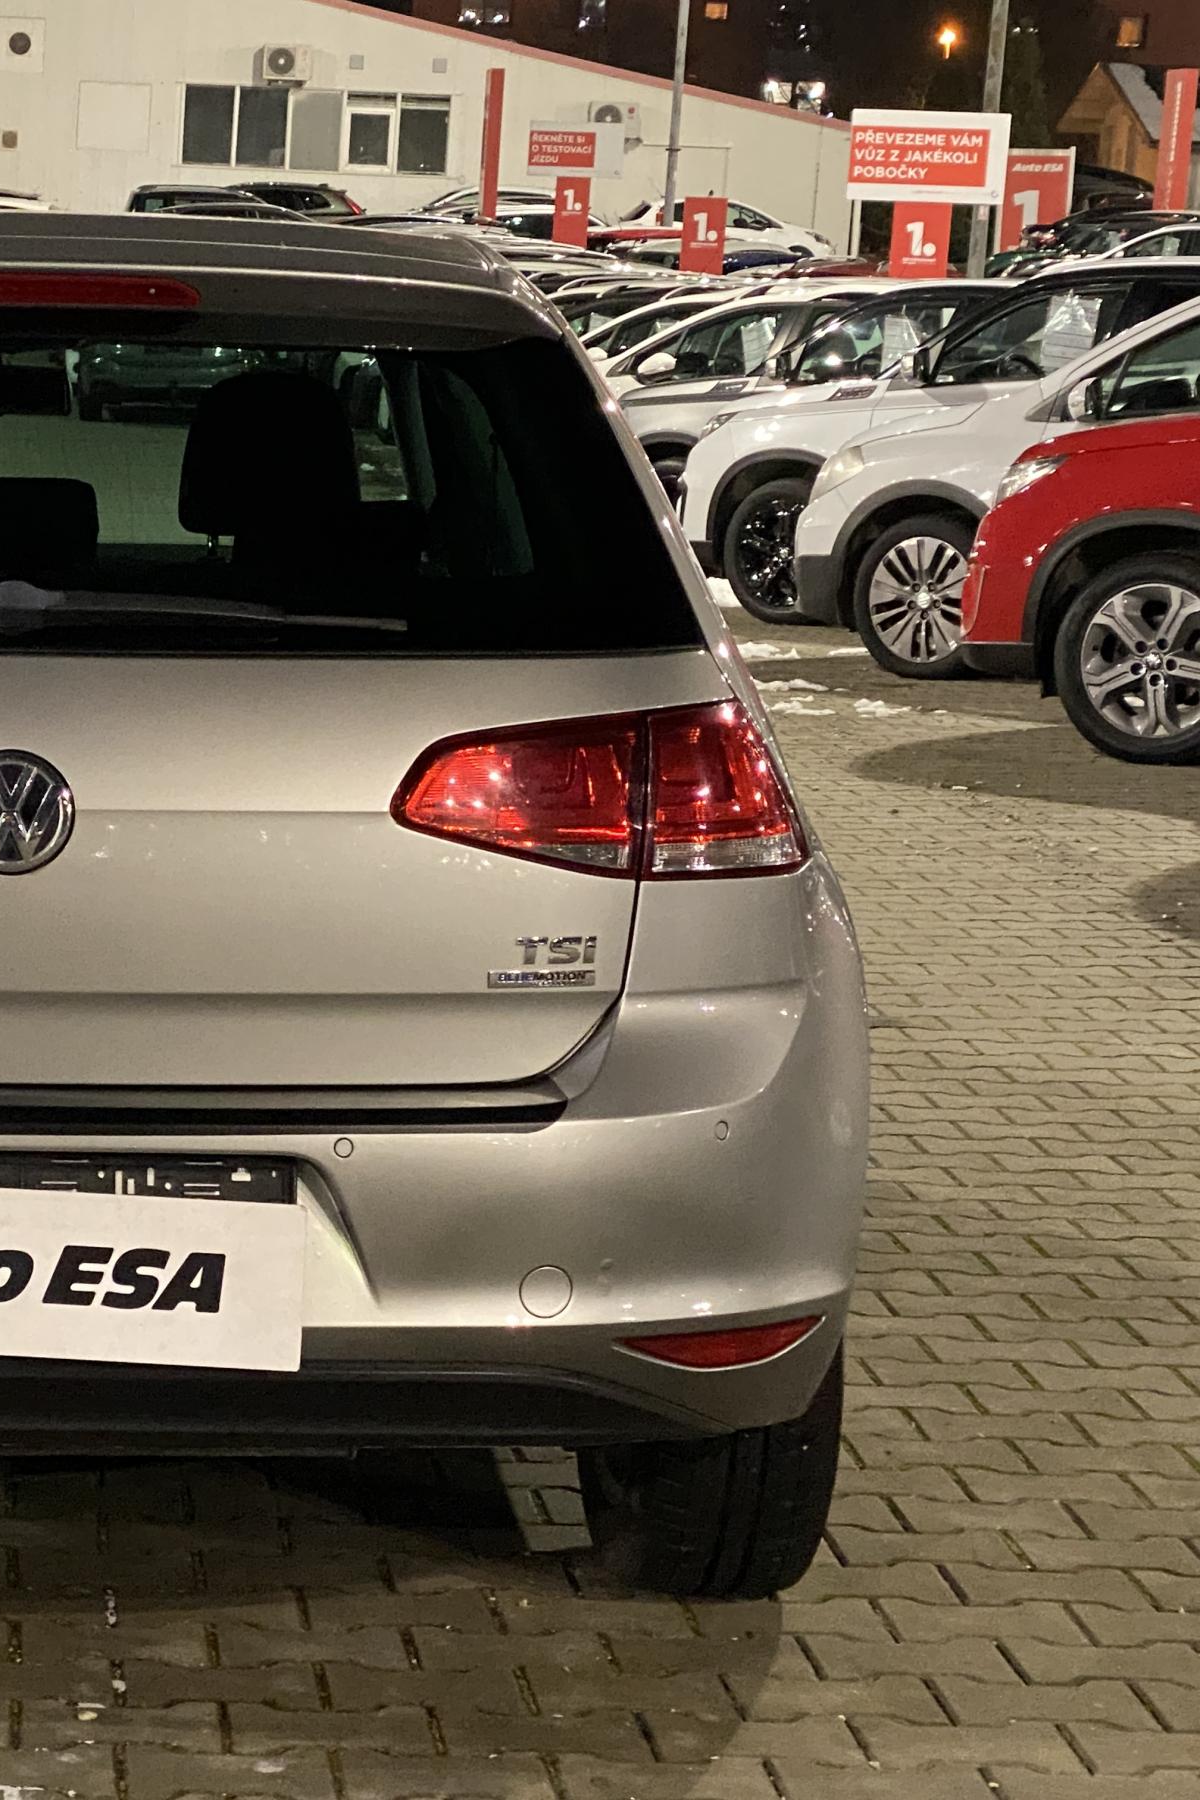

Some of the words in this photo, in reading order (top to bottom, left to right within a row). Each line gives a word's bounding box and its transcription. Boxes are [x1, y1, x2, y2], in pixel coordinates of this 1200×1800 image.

[576, 135, 586, 144] SI
[854, 129, 947, 146] PŘEVEZEME
[950, 133, 984, 148] VÁM
[531, 144, 540, 153] O
[542, 144, 592, 154] TESTOVACÍ
[854, 145, 886, 161] VŮZ
[889, 150, 900, 162] Z
[904, 148, 979, 164] JAKÉKOLI
[853, 164, 928, 180] POBOČKY
[563, 188, 582, 211] 1.
[693, 211, 718, 242] 1.
[906, 221, 937, 257] 1.
[42, 1245, 226, 1313] ESA
